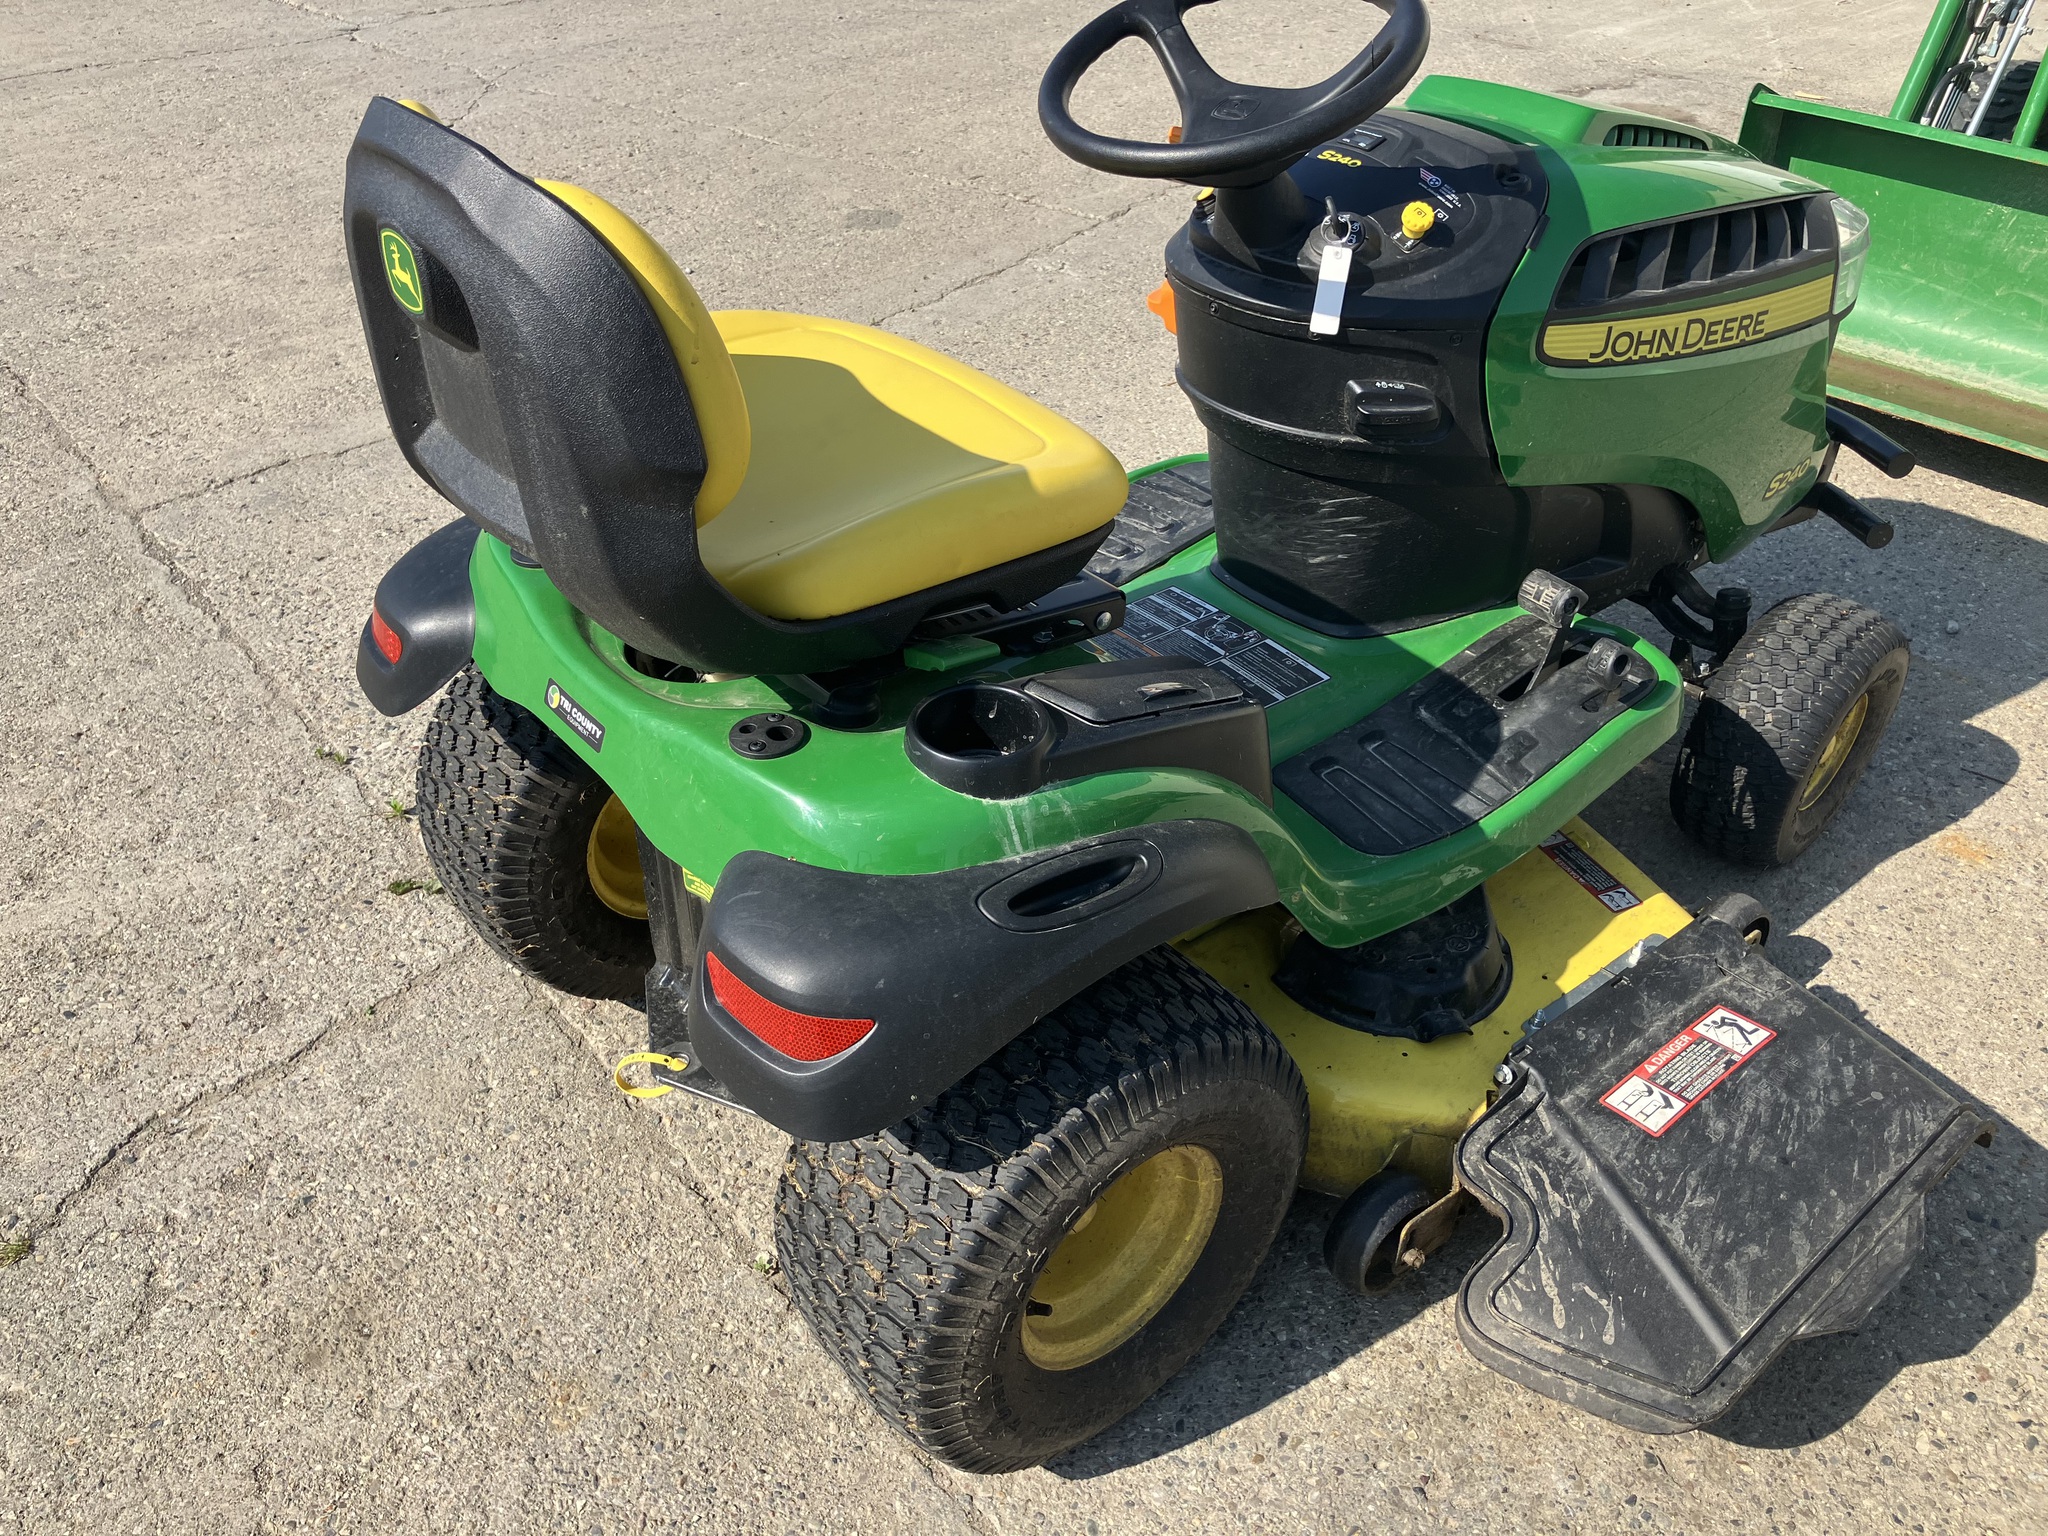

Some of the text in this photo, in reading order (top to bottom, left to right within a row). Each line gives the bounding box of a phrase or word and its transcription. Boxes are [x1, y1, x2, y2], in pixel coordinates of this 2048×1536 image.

[1316, 150, 1362, 167] S240
[1589, 310, 1769, 360] JOHN DEERE
[1762, 456, 1811, 501] S240
[560, 695, 602, 738] TRI COUNTY
[566, 714, 590, 737] EQUIPMENT
[1554, 857, 1580, 880] DANGER
[1651, 1034, 1693, 1066] DANGER
